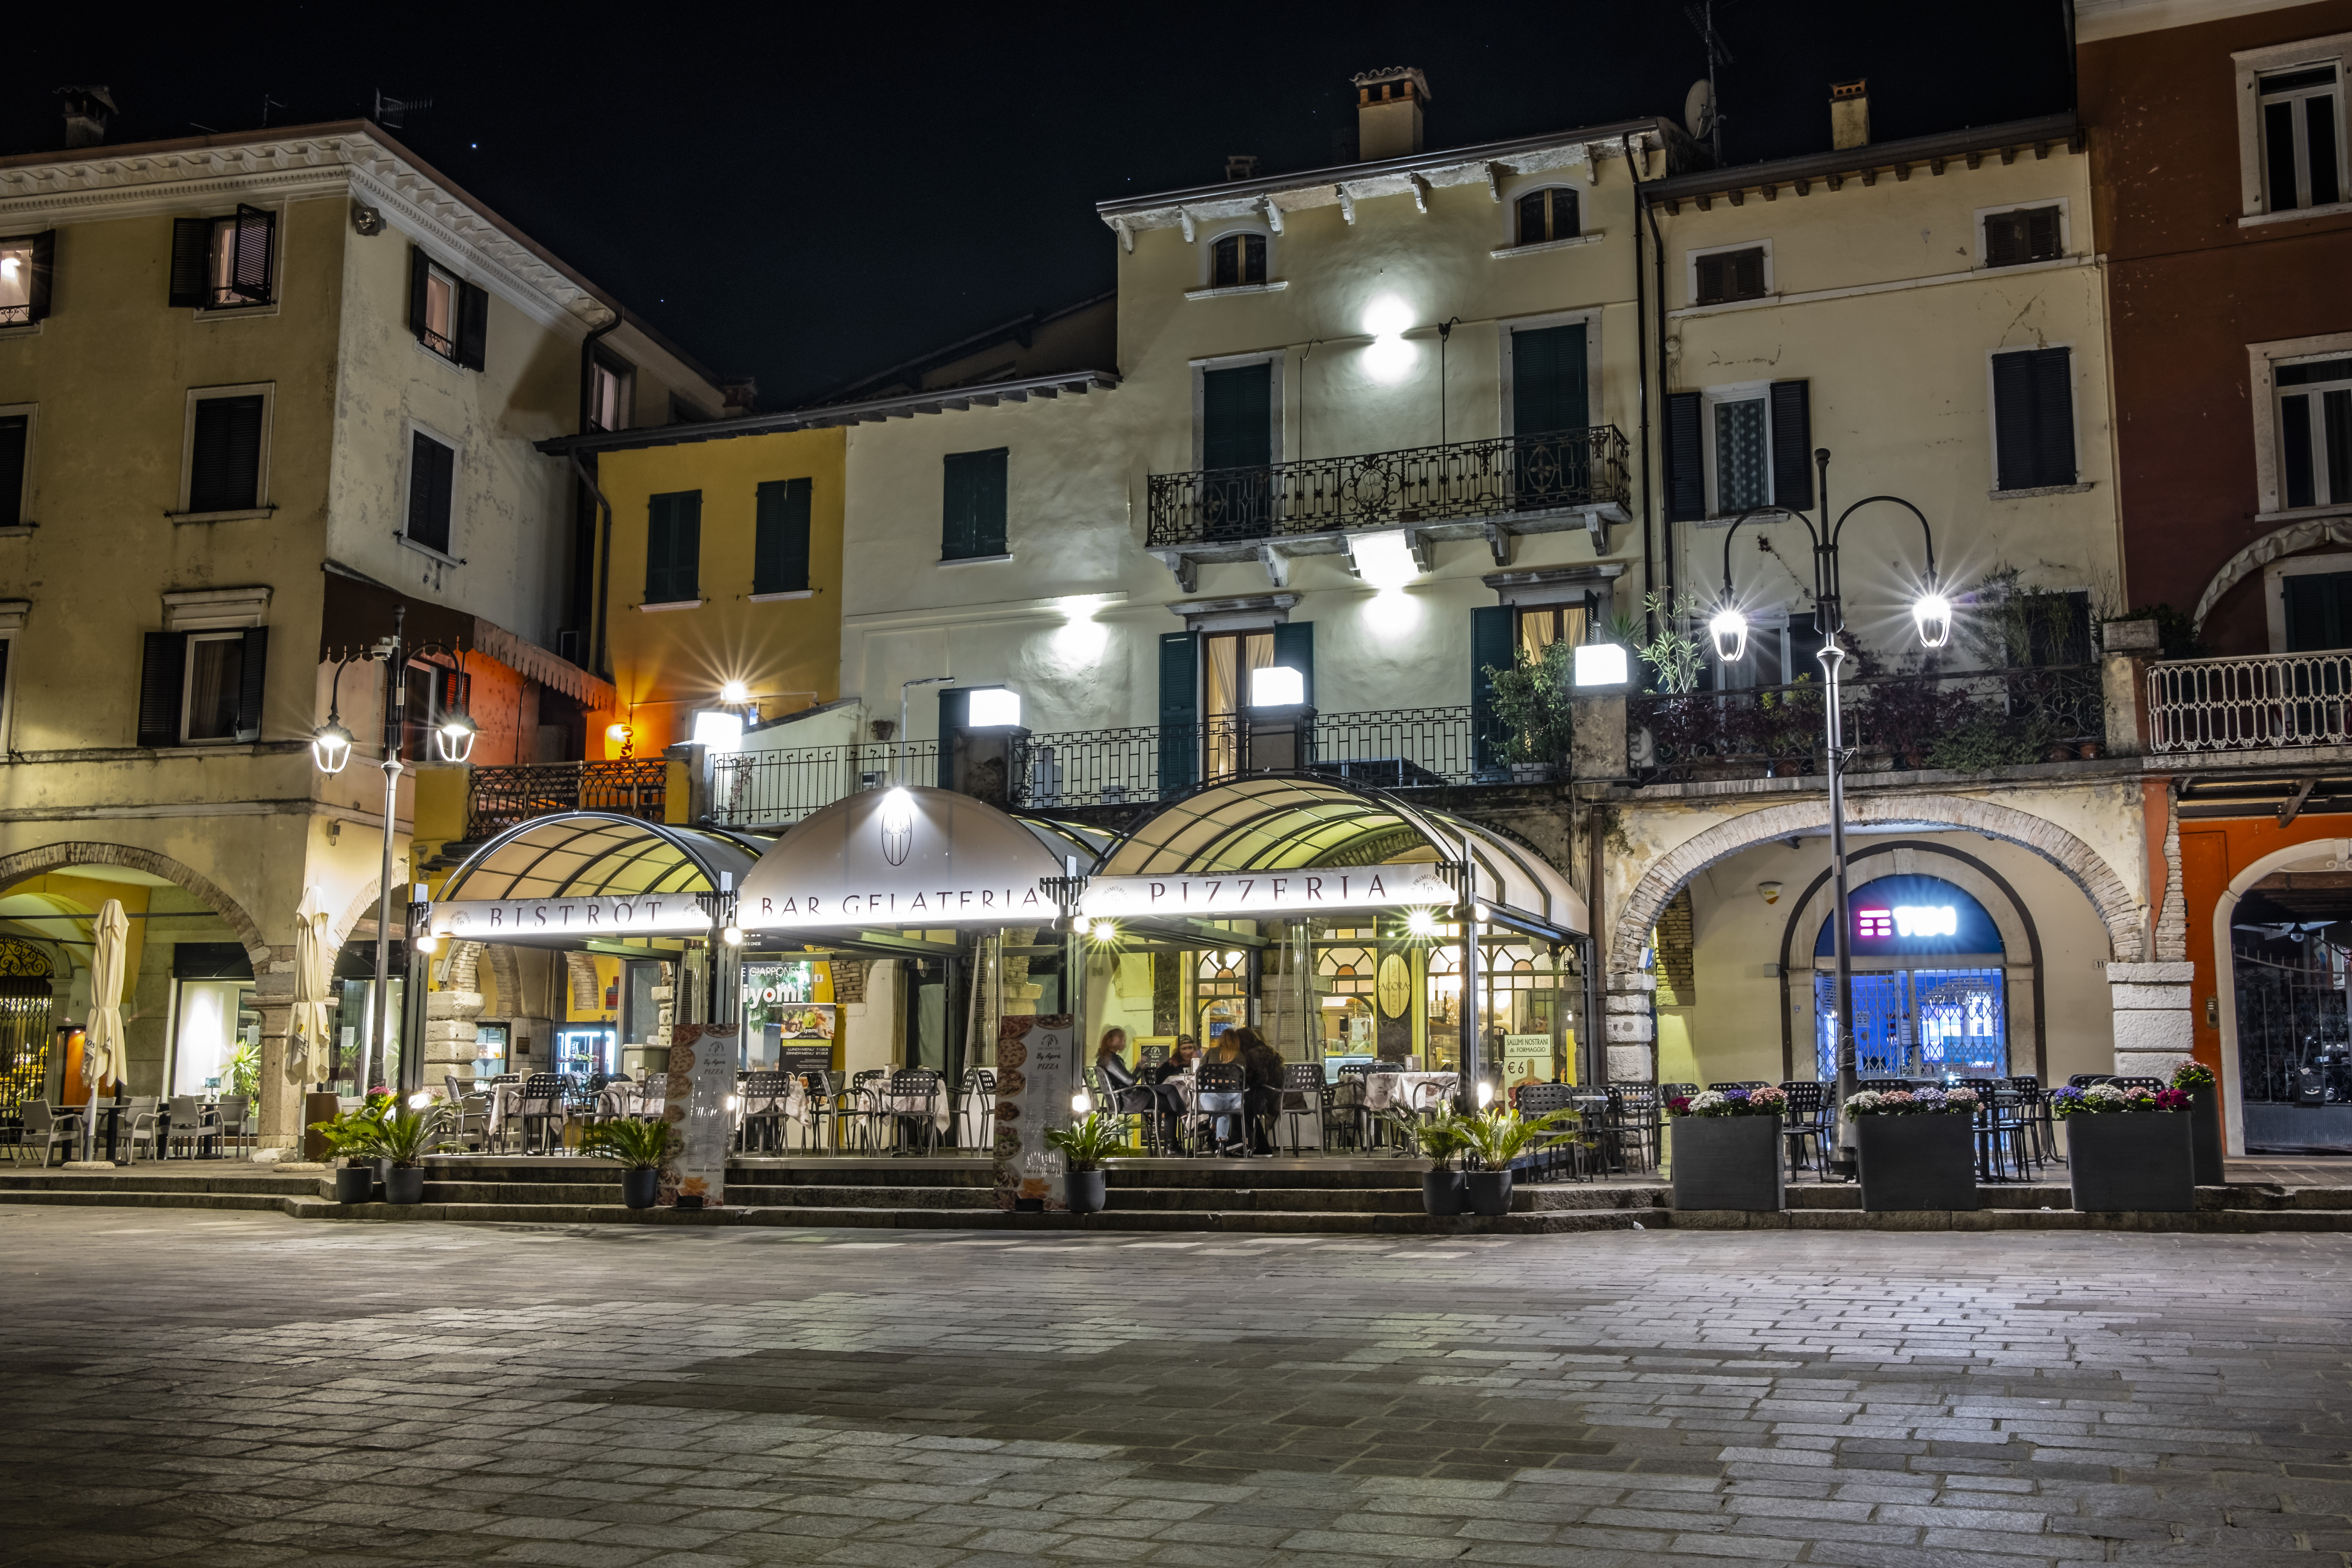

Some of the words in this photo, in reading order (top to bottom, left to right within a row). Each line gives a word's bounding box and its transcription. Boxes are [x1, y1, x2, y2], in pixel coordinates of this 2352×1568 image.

[1413, 874, 1431, 885] PRIMO
[1149, 874, 1386, 905] PIZZERIA
[762, 896, 821, 918] BAR
[843, 887, 1040, 915] GELATERIA
[450, 910, 464, 920] PRIMO
[490, 902, 662, 928] BISTROT
[749, 967, 803, 977] GIAPPONES
[1036, 1053, 1044, 1061] By
[1518, 1062, 1524, 1074] 6
